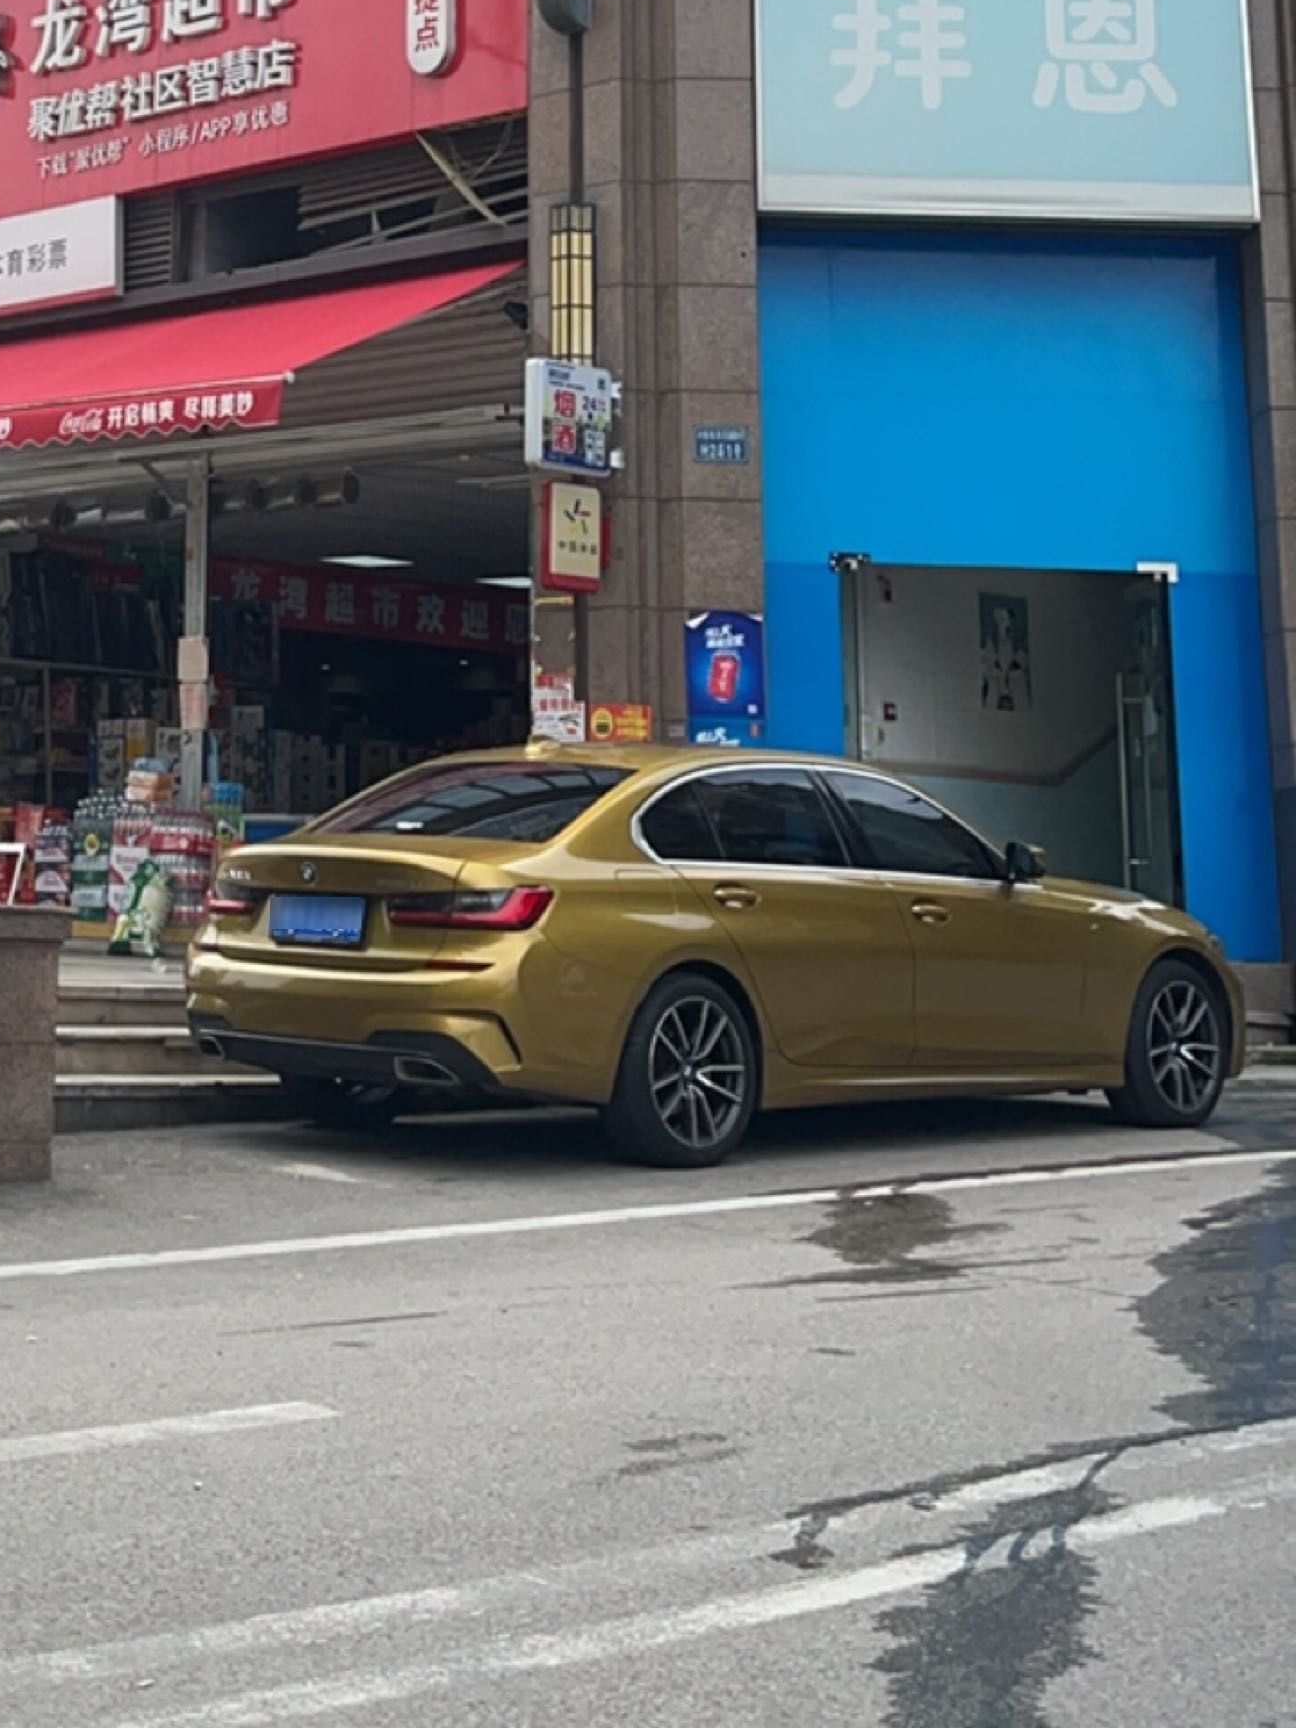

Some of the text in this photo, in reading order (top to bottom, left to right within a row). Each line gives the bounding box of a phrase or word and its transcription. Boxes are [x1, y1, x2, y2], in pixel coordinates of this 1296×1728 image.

[27, 40, 298, 142] 聚优帮社区智慧店
